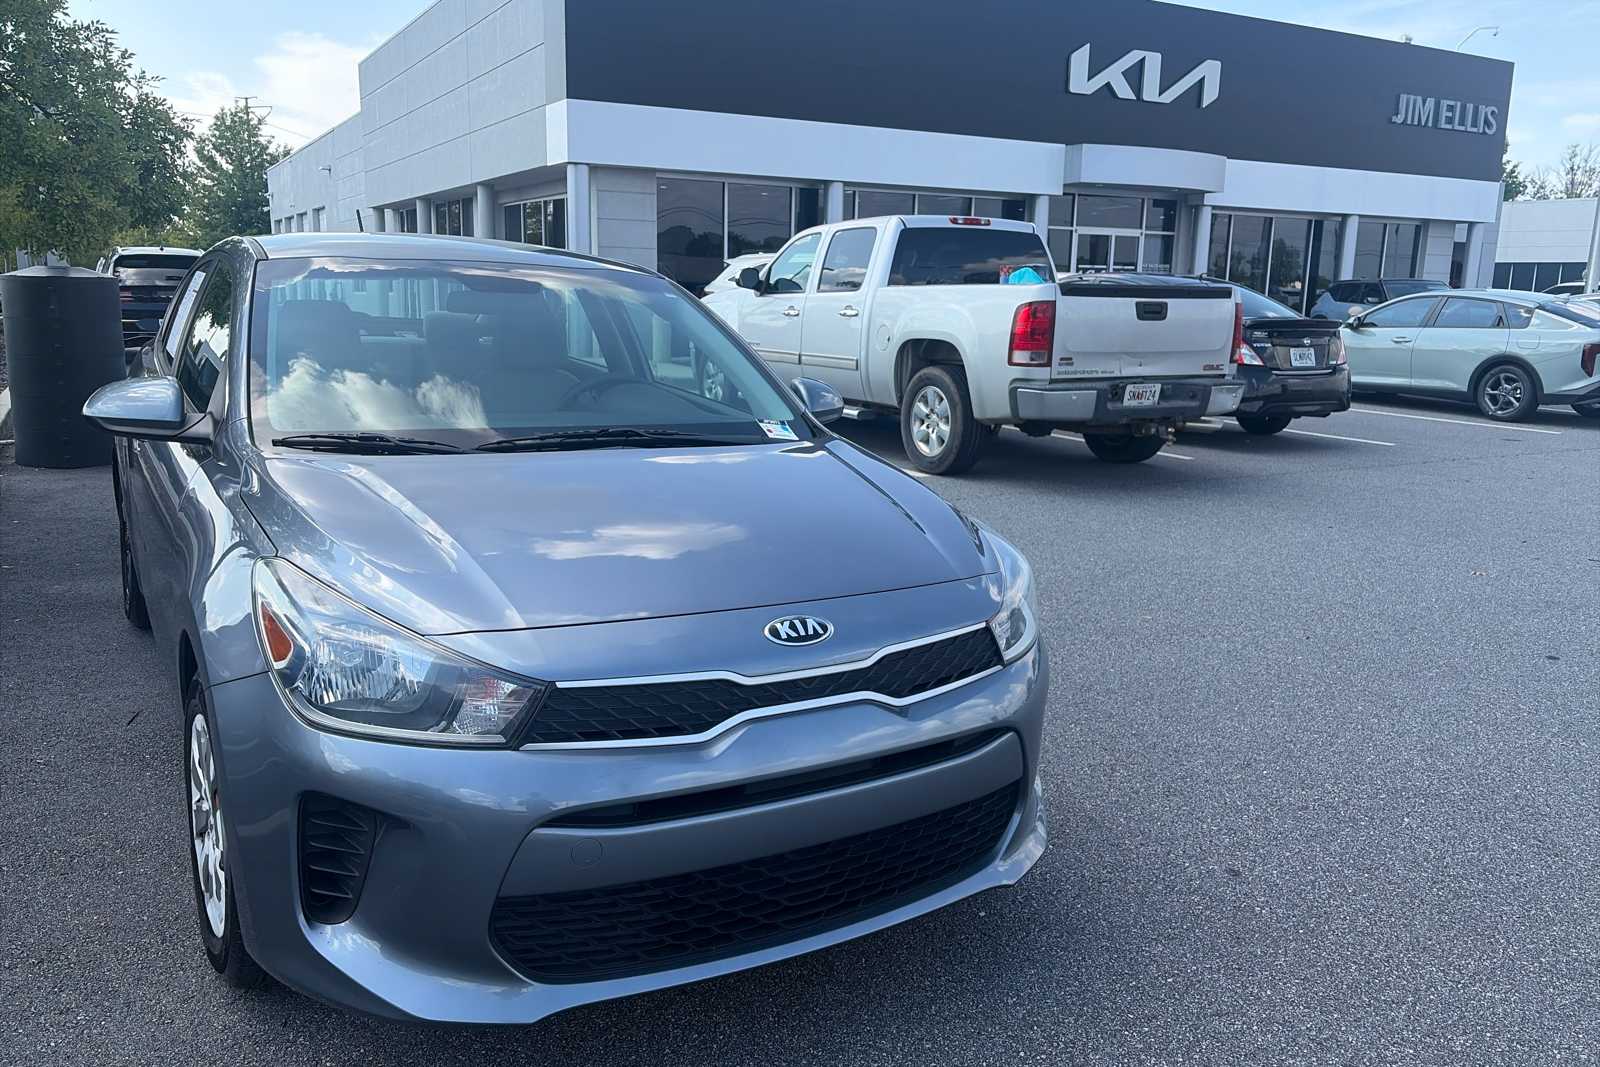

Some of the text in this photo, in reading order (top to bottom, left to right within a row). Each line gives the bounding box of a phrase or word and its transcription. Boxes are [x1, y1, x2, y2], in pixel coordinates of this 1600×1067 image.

[1069, 42, 1222, 109] KIA
[1391, 93, 1498, 135] JIM ELLIS
[774, 618, 825, 640] KIA
